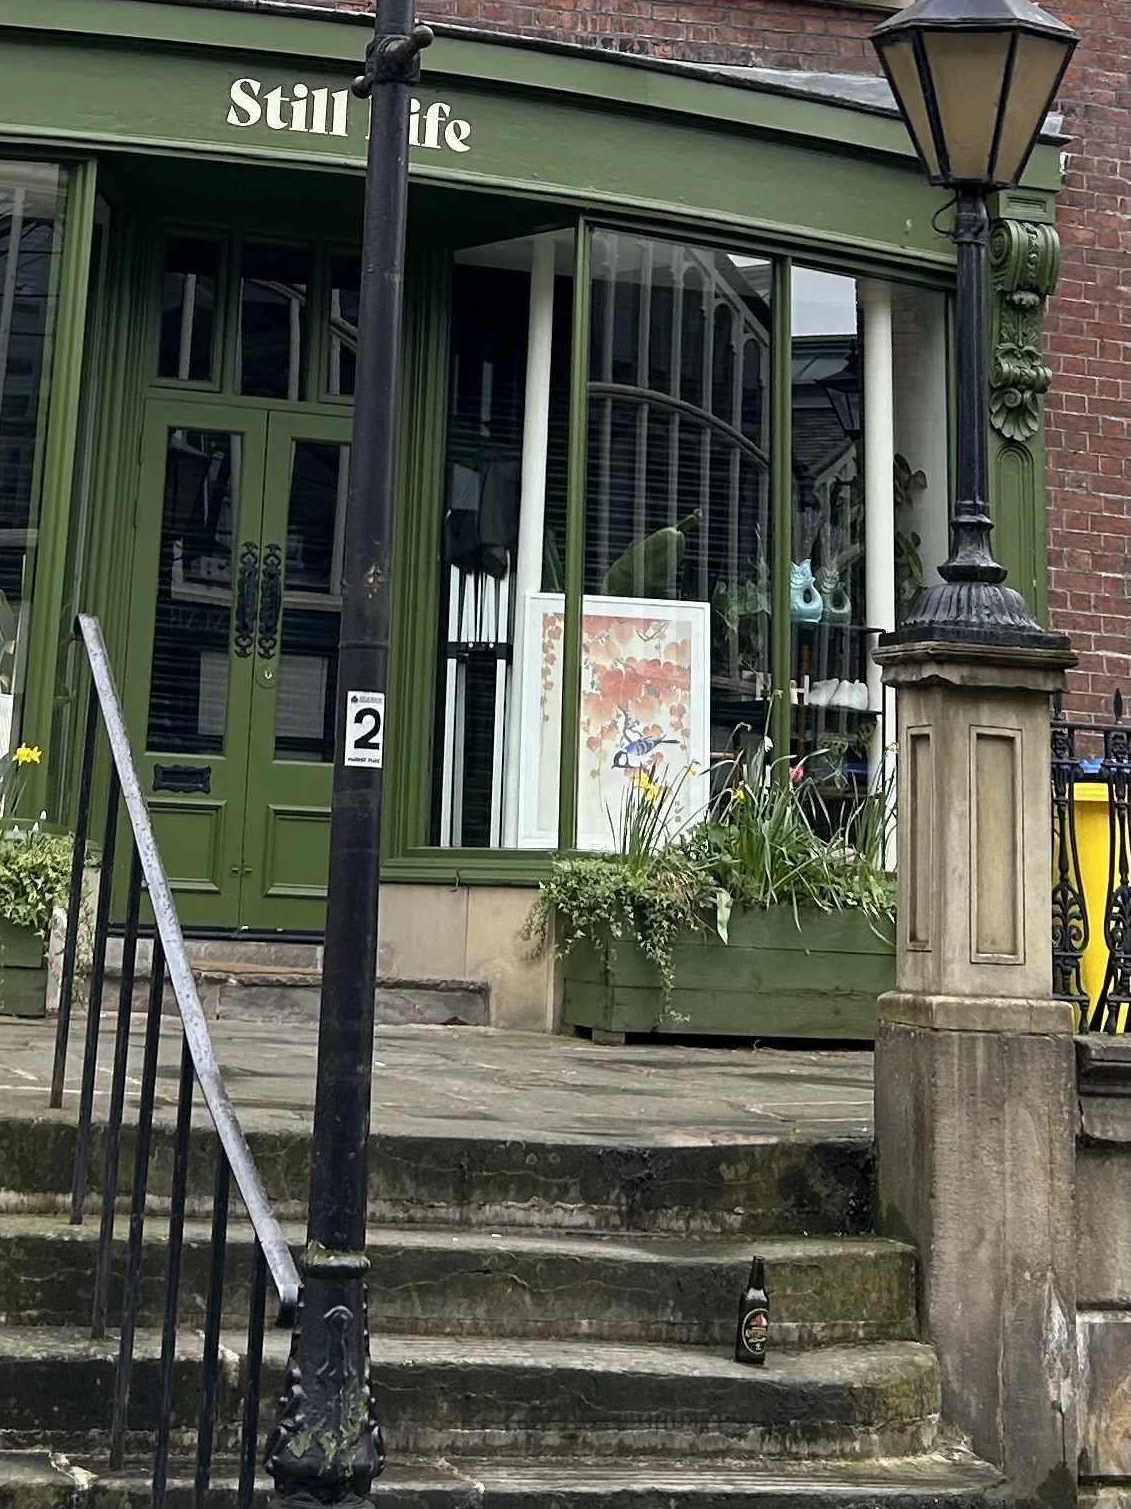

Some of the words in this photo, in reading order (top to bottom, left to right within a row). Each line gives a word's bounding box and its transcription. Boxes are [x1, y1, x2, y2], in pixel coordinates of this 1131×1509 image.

[226, 78, 349, 137] Still
[365, 95, 471, 153] ife
[354, 707, 381, 750] 2
